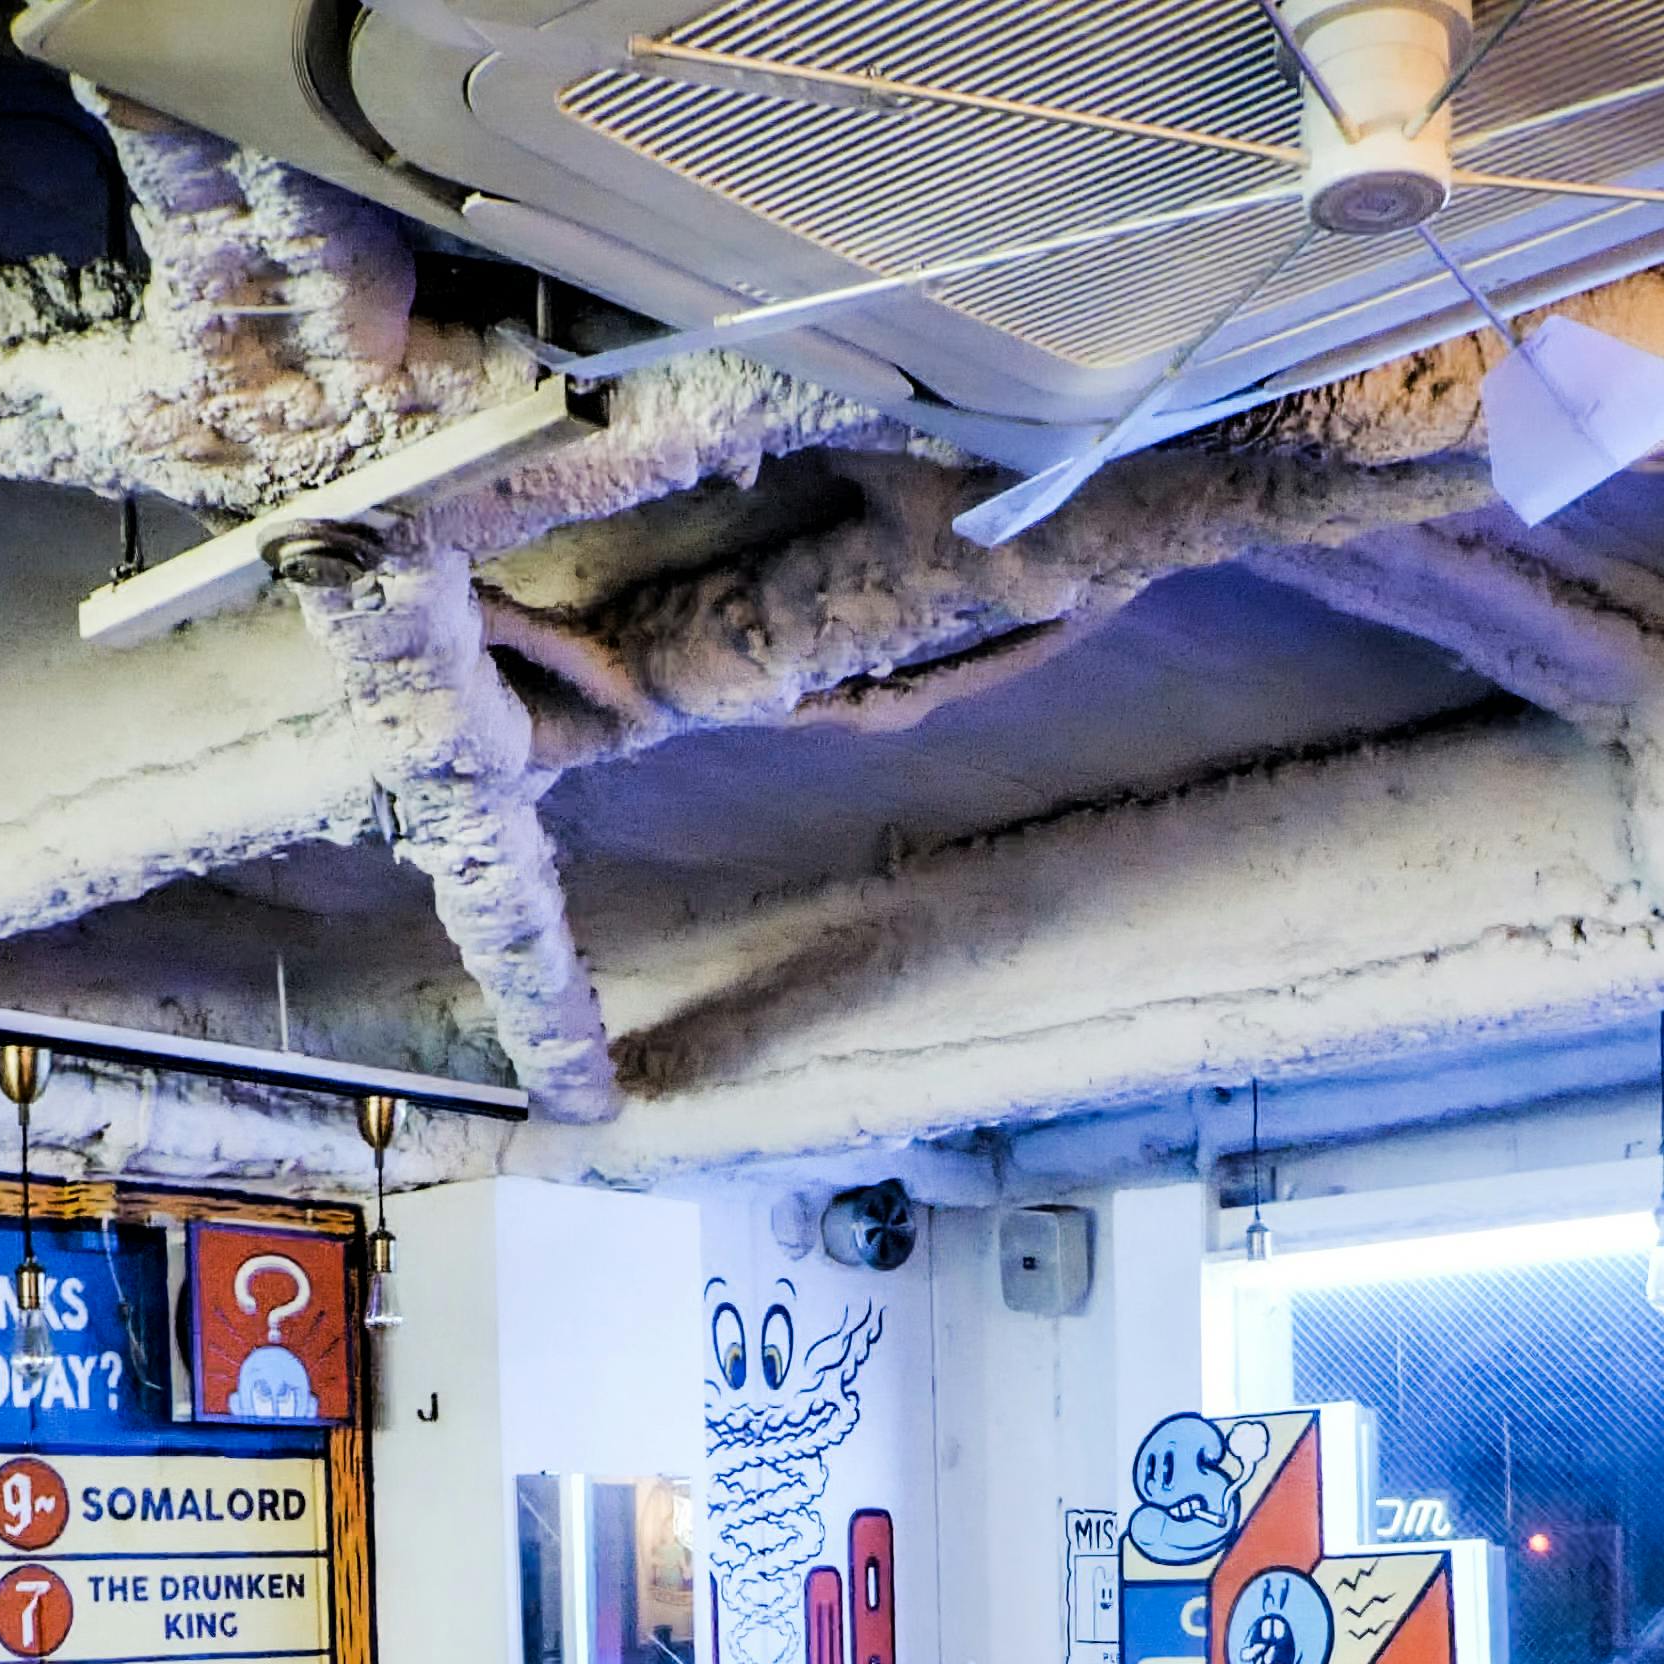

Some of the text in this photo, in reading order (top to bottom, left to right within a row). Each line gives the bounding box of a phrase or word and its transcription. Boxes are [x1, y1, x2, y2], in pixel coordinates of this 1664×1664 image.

[81, 1486, 306, 1522] SOMALORD
[1075, 1516, 1117, 1550] MIS
[88, 1573, 305, 1602] THE DRUNKEN
[15, 1580, 51, 1648] 7
[164, 1612, 238, 1640] KING
